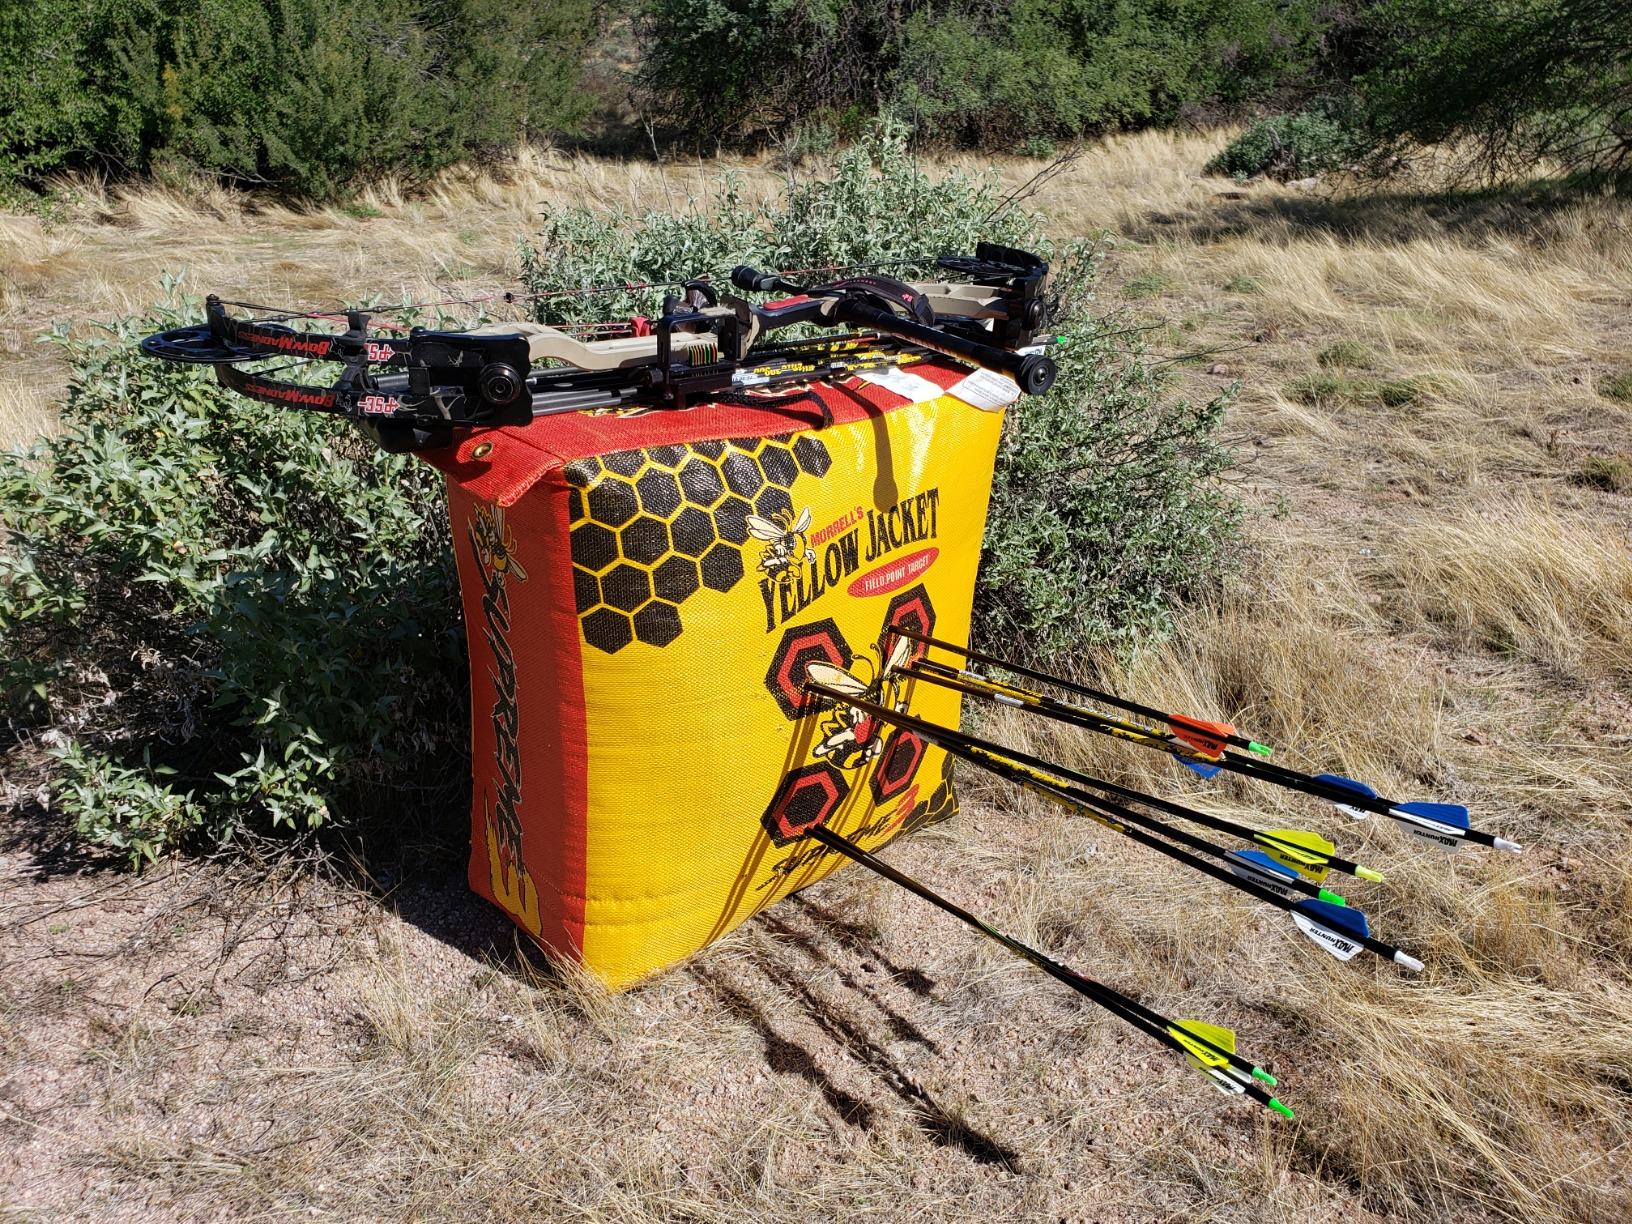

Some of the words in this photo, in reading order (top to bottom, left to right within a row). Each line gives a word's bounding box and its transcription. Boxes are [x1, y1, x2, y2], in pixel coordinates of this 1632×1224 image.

[362, 343, 396, 361] PS
[358, 396, 400, 414] PSE
[810, 505, 864, 548] MORRELL'S
[758, 527, 860, 634] YELLOW
[865, 487, 940, 563] JACKET
[865, 575, 885, 592] FIELD
[886, 567, 905, 584] POINT
[907, 554, 930, 574] TARGET
